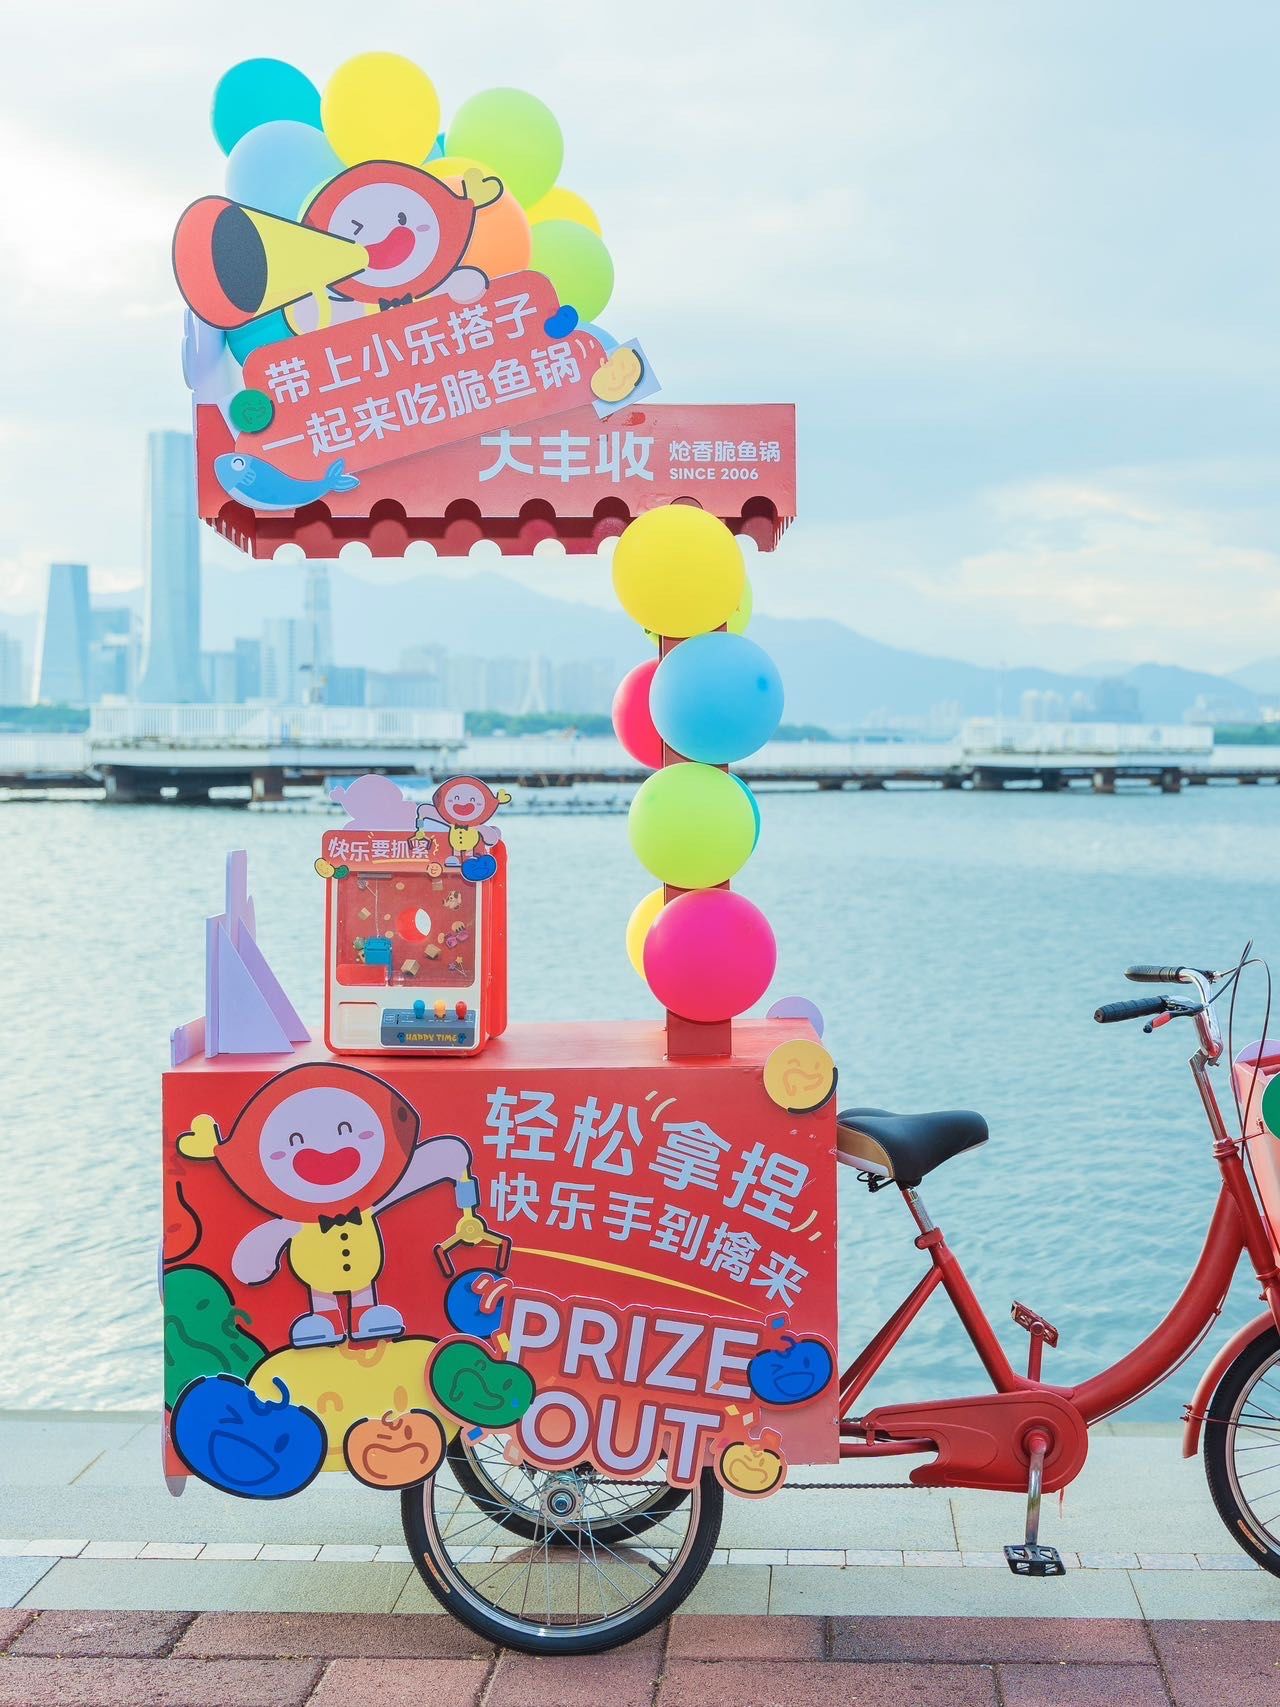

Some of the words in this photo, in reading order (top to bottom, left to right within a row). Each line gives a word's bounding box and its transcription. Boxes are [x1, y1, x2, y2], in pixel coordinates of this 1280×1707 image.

[264, 291, 540, 406] 带上小乐搭子
[261, 341, 581, 459] 一起来吃脆鱼锅
[478, 429, 655, 484] 大丰收
[669, 440, 781, 462] 炝香脆鱼锅
[669, 467, 716, 480] SINCE
[720, 467, 759, 480] 2006
[328, 836, 429, 861] 快乐要抓紧
[437, 1033, 458, 1043] TIME
[483, 1086, 809, 1231] 轻松拿捏
[490, 1171, 809, 1308] 快乐手到擒来
[506, 1298, 760, 1399] PRIZE
[521, 1391, 721, 1480] OUT
